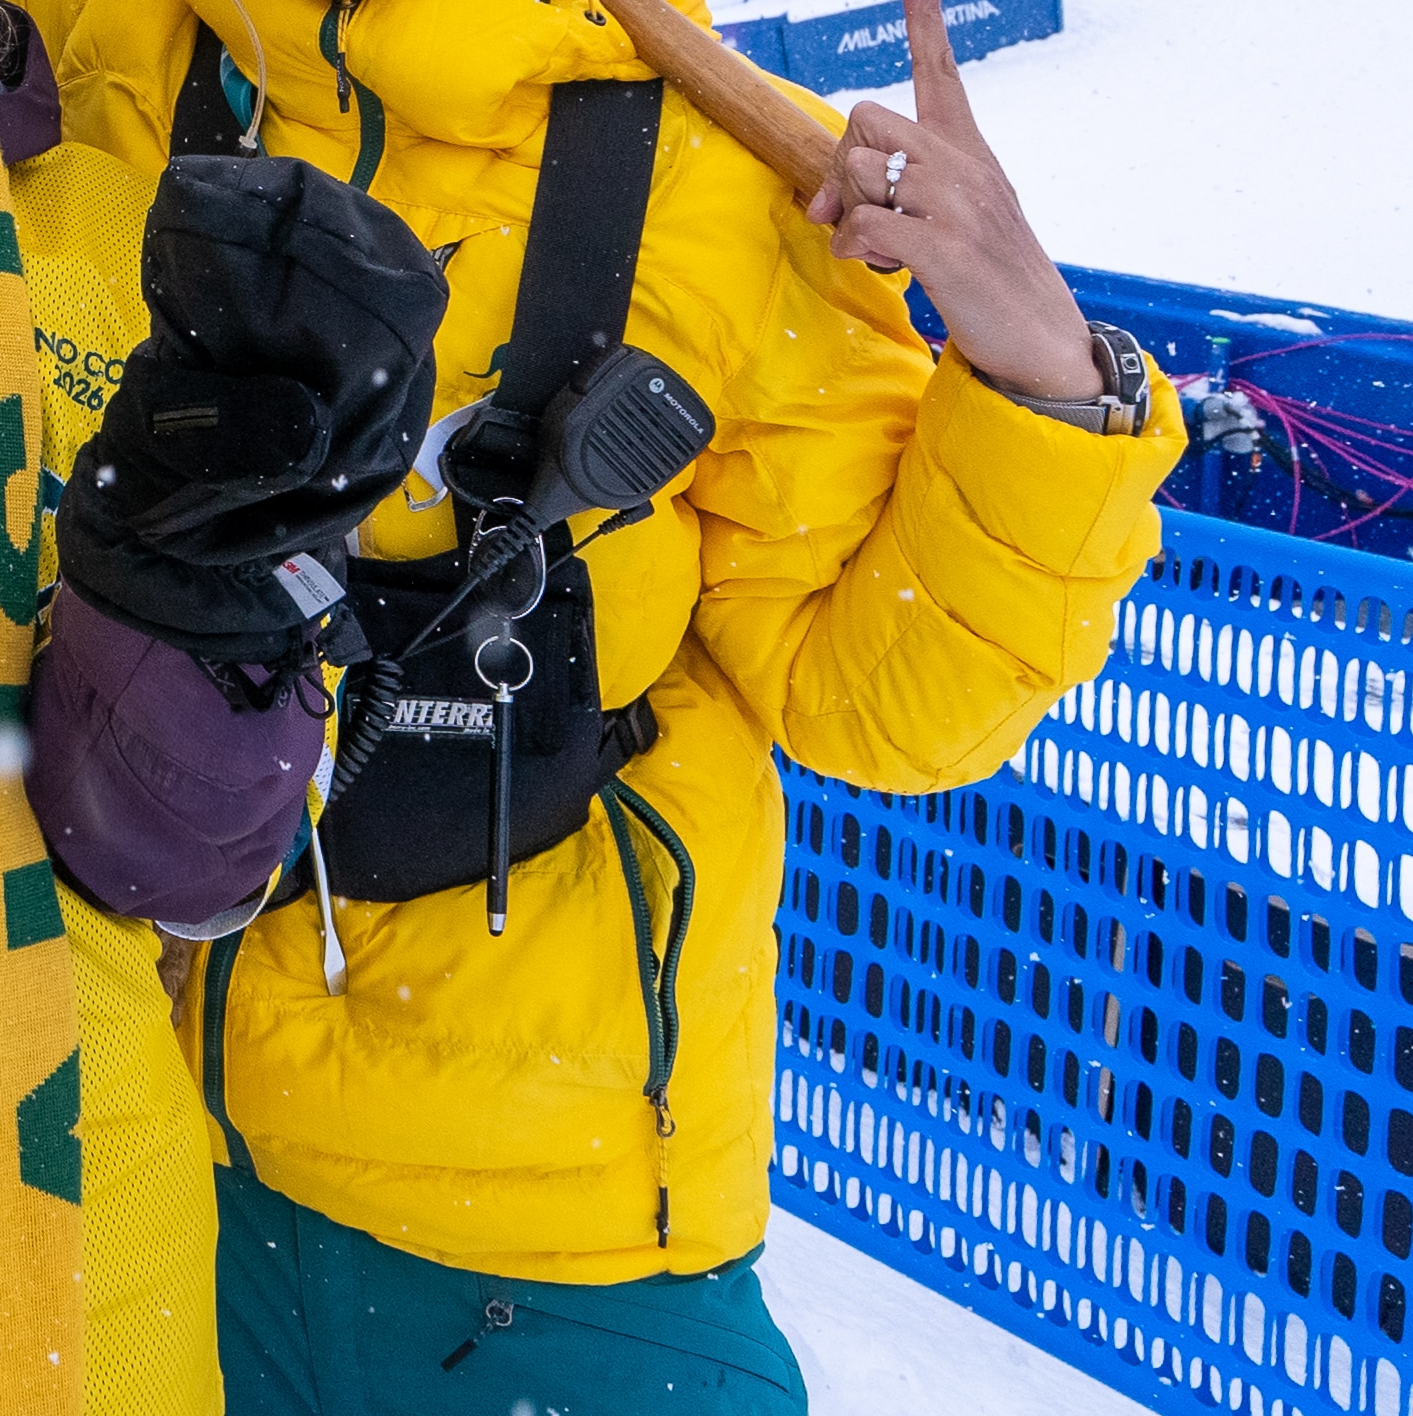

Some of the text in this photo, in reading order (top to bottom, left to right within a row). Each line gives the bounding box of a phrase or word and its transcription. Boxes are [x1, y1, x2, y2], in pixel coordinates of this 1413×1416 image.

[53, 363, 105, 411] 2026
[663, 392, 705, 435] MOTOROLA
[392, 699, 493, 726] NTERR
